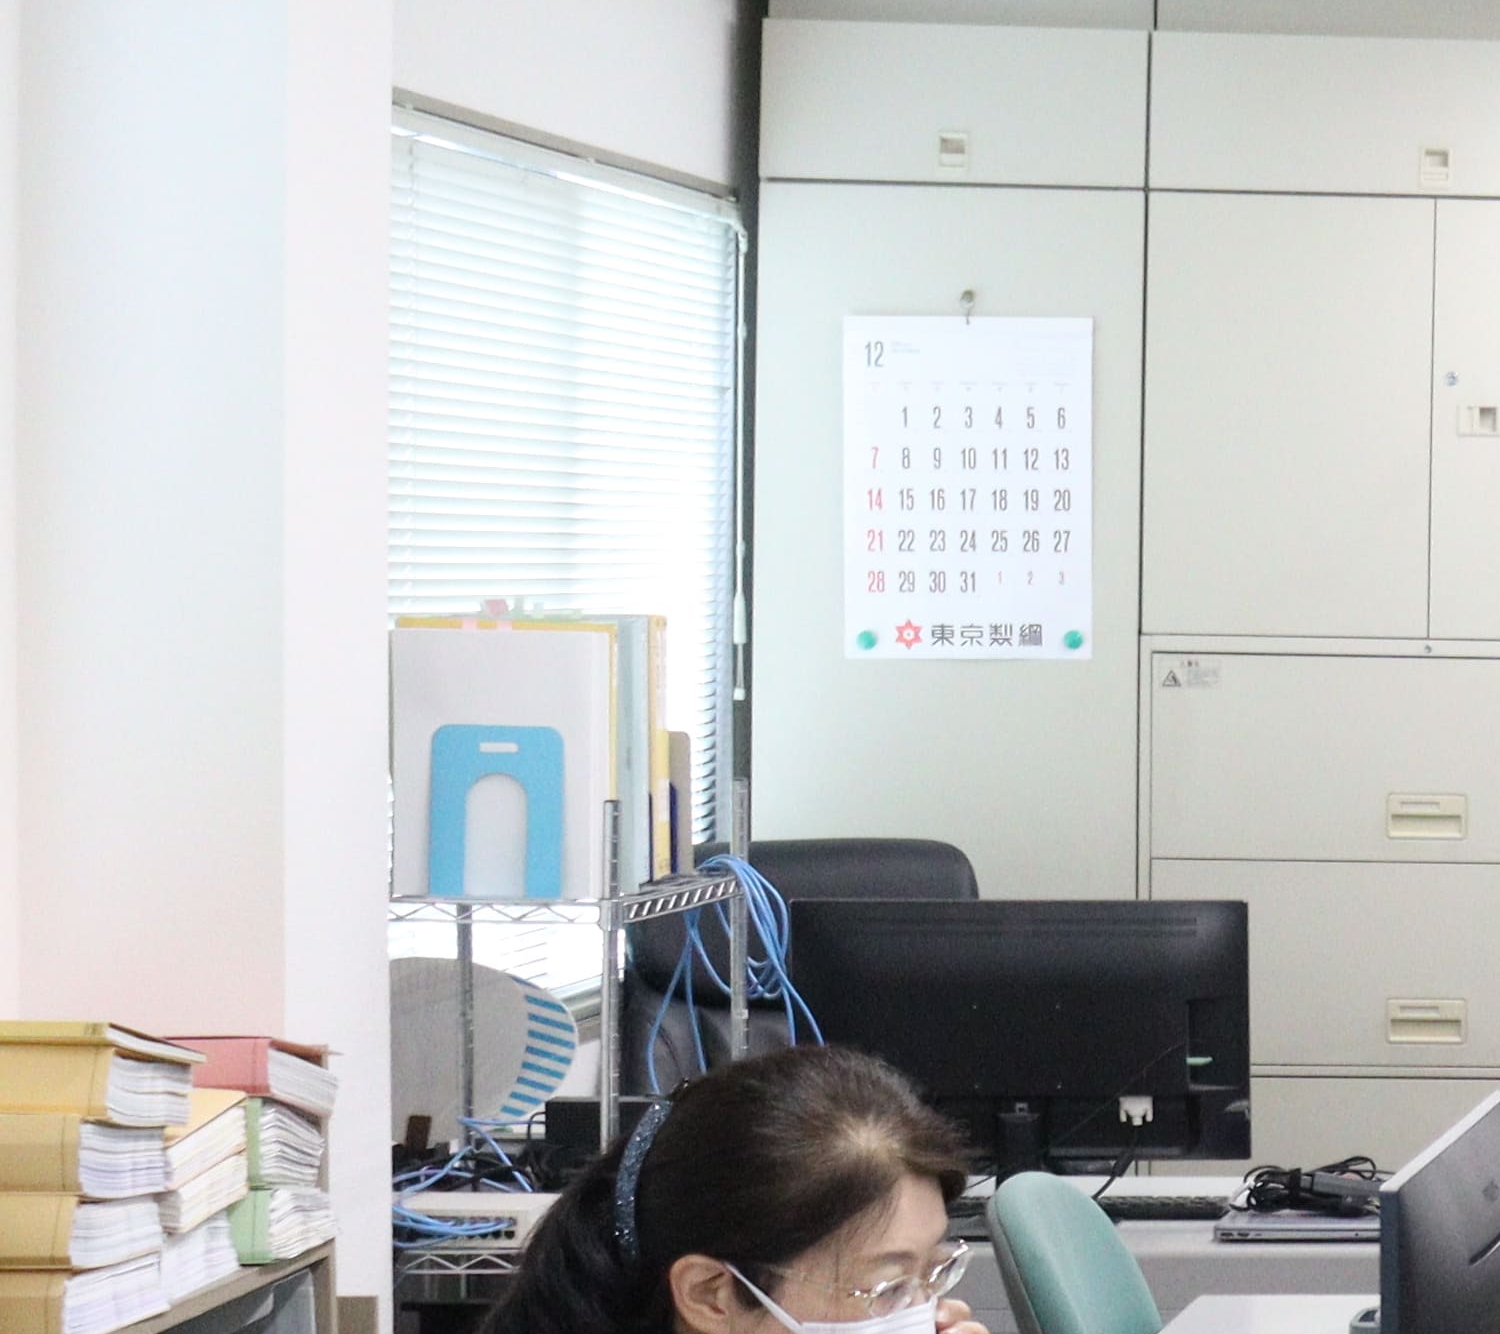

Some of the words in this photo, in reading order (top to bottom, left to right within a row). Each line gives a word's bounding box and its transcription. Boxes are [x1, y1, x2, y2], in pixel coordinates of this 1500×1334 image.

[865, 341, 885, 368] 12
[901, 405, 908, 428] 1
[932, 405, 942, 430] 2
[963, 405, 974, 430] 3
[994, 405, 1004, 430] 4
[1026, 405, 1036, 430] 5
[1056, 406, 1067, 430] 6
[871, 445, 880, 470] 7
[901, 446, 911, 470] 8
[932, 446, 942, 470] 9
[960, 446, 977, 470] 10
[992, 447, 1008, 471] 11
[1023, 447, 1039, 471] 12
[1053, 447, 1070, 471] 13
[867, 487, 884, 511] 14
[898, 487, 915, 512] 15
[929, 487, 946, 511] 16
[959, 487, 977, 512] 17
[991, 488, 1008, 512] 18
[1023, 488, 1040, 512] 19
[1053, 488, 1071, 512] 20
[866, 528, 884, 553] 21
[897, 528, 916, 553] 22
[928, 528, 946, 553] 23
[959, 529, 977, 553] 24
[991, 528, 1009, 553] 25
[1022, 529, 1040, 553] 26
[1053, 529, 1071, 554] 27
[867, 570, 886, 594] 28
[898, 570, 916, 594] 29
[928, 570, 947, 594] 30
[959, 570, 976, 594] 31
